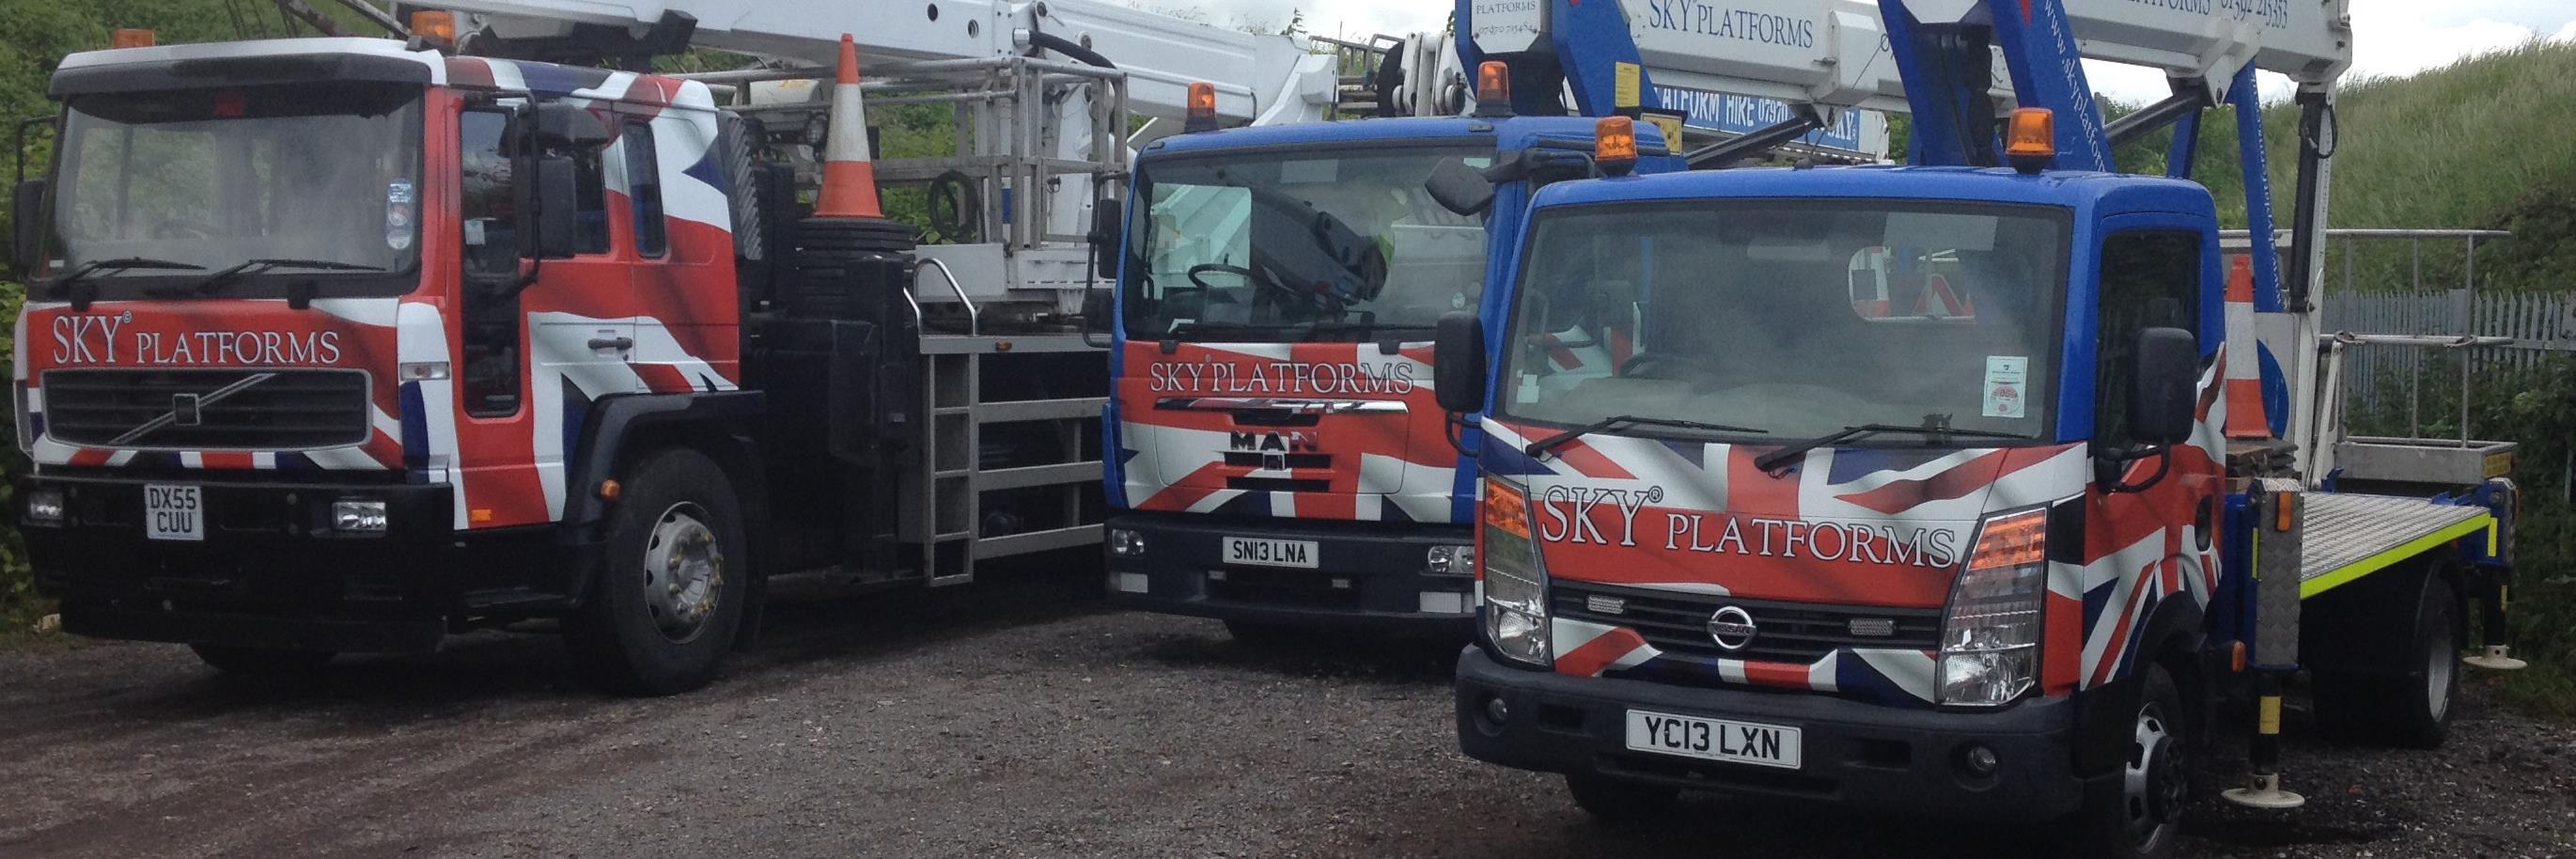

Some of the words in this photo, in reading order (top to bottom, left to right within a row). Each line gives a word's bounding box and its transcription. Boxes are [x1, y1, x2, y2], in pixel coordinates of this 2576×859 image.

[1696, 4, 1813, 48] PLATFORMS
[135, 331, 341, 365] PLATFORMS
[1211, 362, 1414, 395] PLATFORMS
[1230, 430, 1318, 452] MAN
[149, 488, 196, 509] DX55
[157, 511, 193, 533] CUU
[1233, 539, 1269, 561] SN13
[1273, 542, 1307, 564] LNA
[1664, 513, 1956, 570] PLATFORMS
[1645, 715, 1710, 752] YC13
[1720, 724, 1780, 760] LXN
